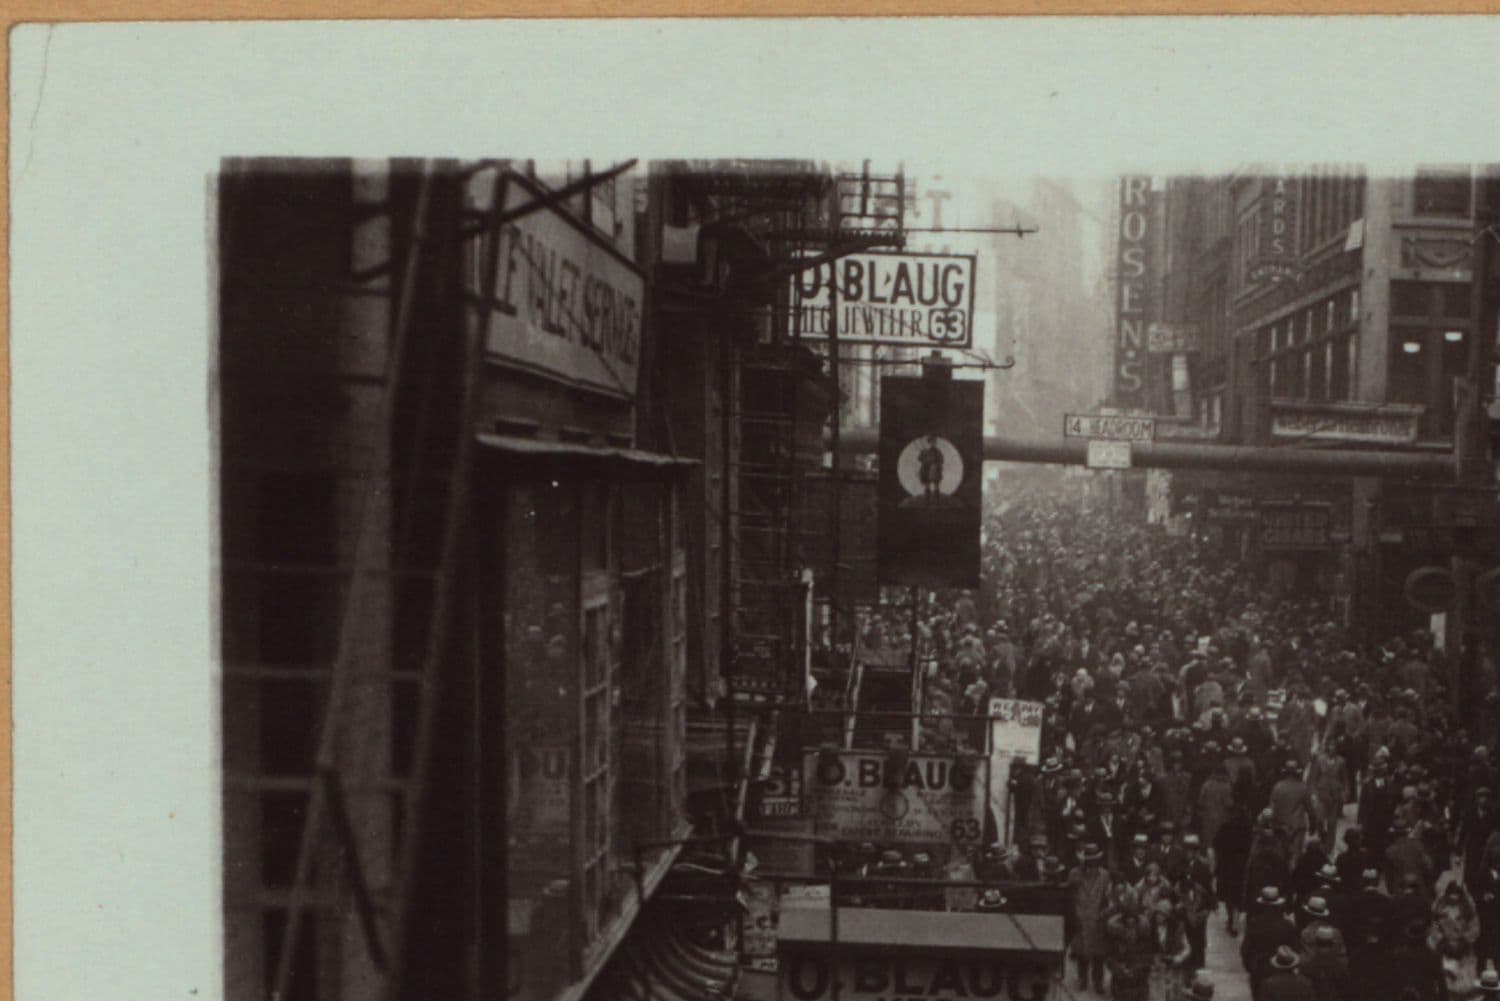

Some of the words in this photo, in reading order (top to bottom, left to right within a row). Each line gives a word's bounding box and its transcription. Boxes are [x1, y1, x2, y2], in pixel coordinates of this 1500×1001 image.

[843, 259, 964, 306] BLAUG
[929, 309, 965, 341] 63
[951, 818, 981, 841] 63
